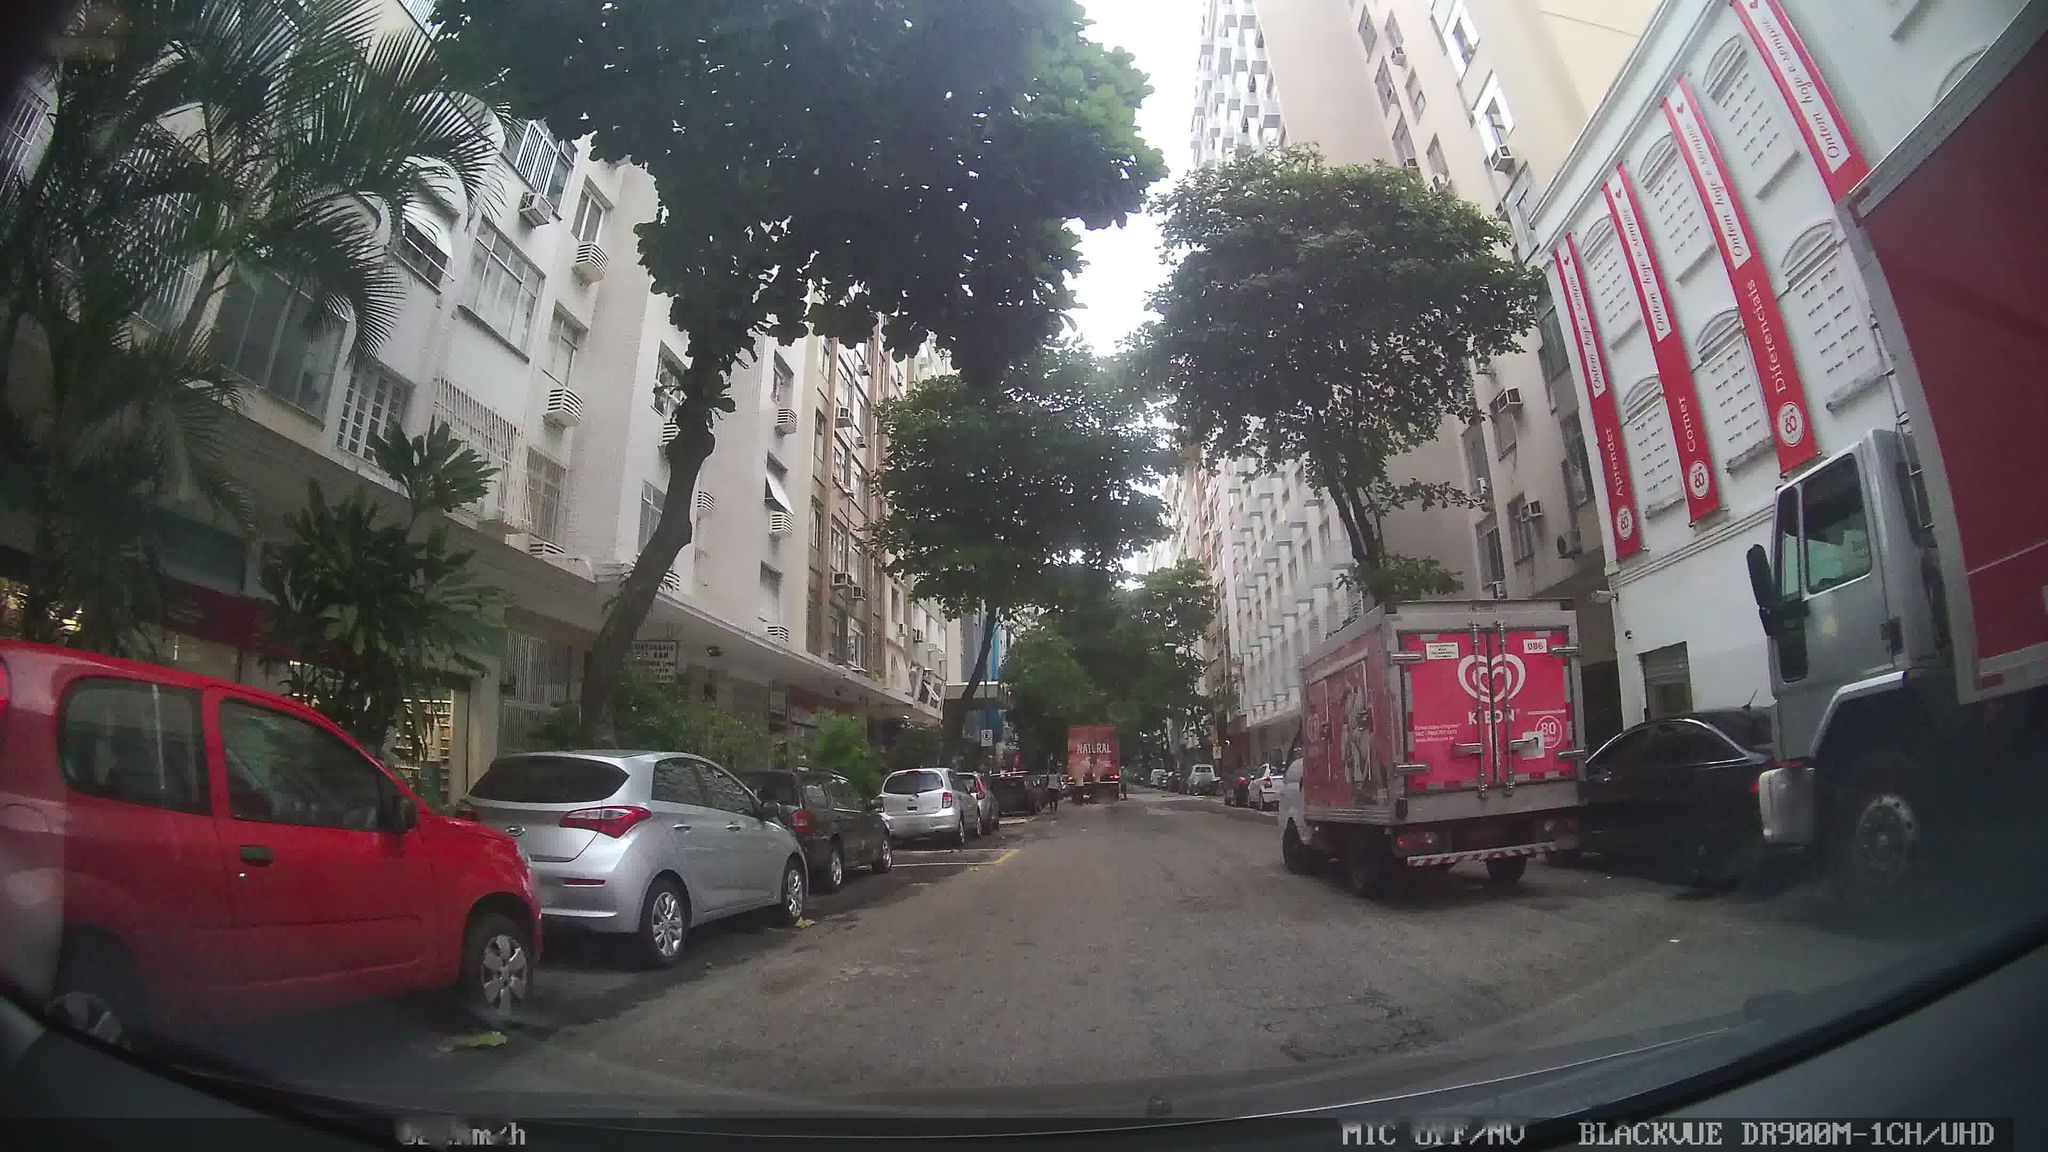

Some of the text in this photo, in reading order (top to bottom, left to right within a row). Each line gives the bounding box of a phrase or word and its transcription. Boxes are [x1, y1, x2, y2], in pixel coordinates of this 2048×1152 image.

[1747, 279, 1787, 394] Diferenciais
[1678, 396, 1696, 452] Comer
[1605, 427, 1623, 497] Aprender
[1468, 708, 1515, 725] KBON
[1541, 722, 1556, 736] 80
